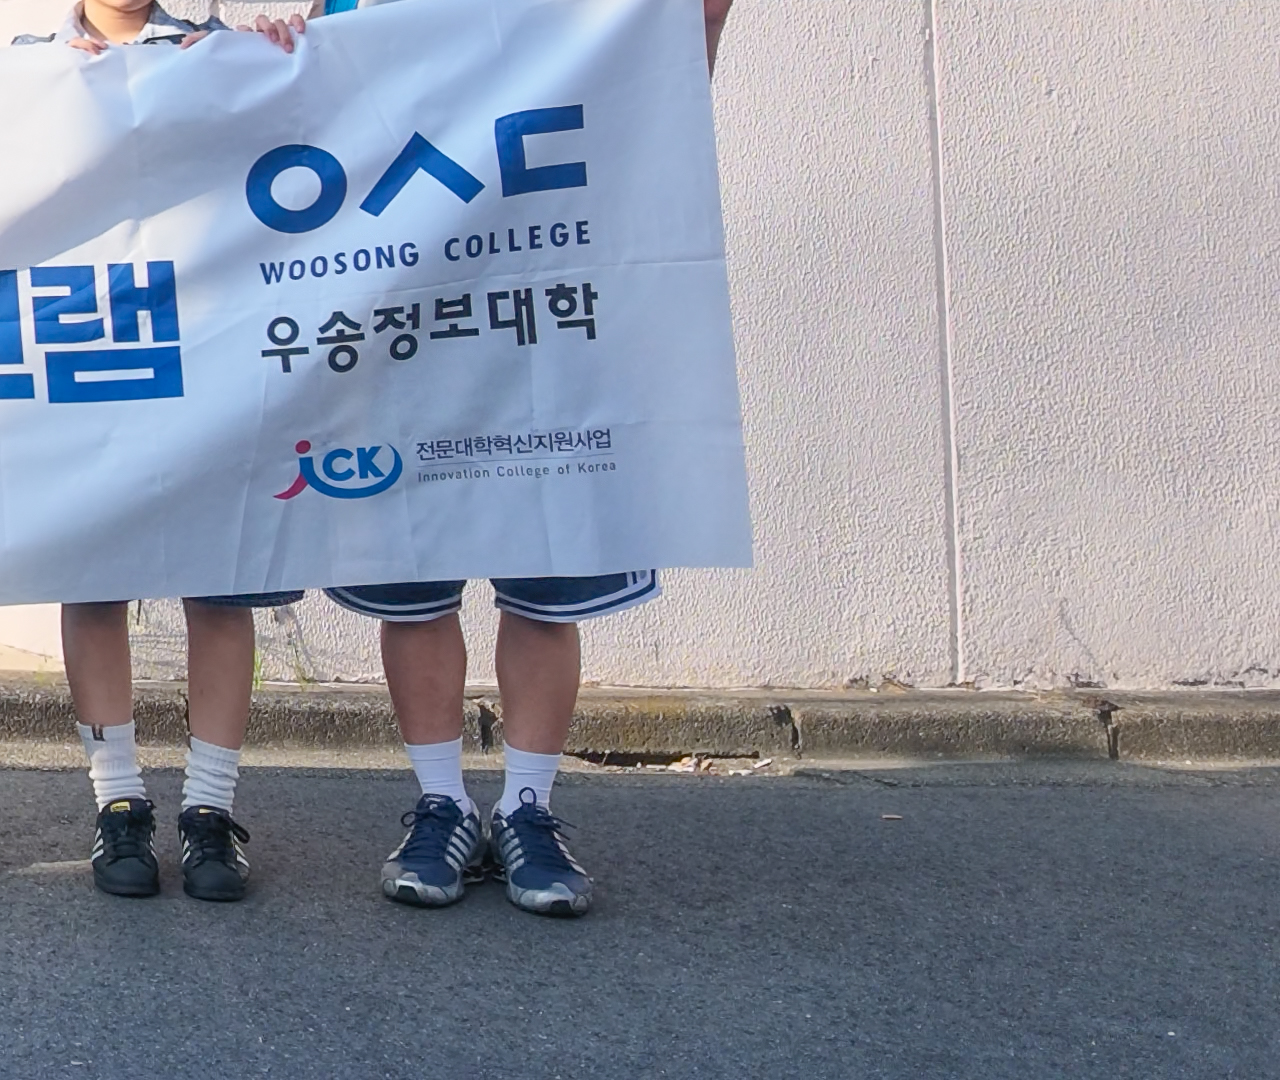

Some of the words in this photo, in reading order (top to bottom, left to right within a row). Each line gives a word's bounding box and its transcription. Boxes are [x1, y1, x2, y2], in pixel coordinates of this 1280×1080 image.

[260, 241, 420, 285] WOOSONG
[444, 220, 591, 262] COLLEGE
[260, 282, 599, 374] 우송정보대학
[415, 428, 613, 462] 전문대학혁신지원사업
[417, 467, 491, 483] Innovation
[496, 465, 550, 480] College
[558, 464, 571, 476] of
[578, 461, 617, 474] Korea
